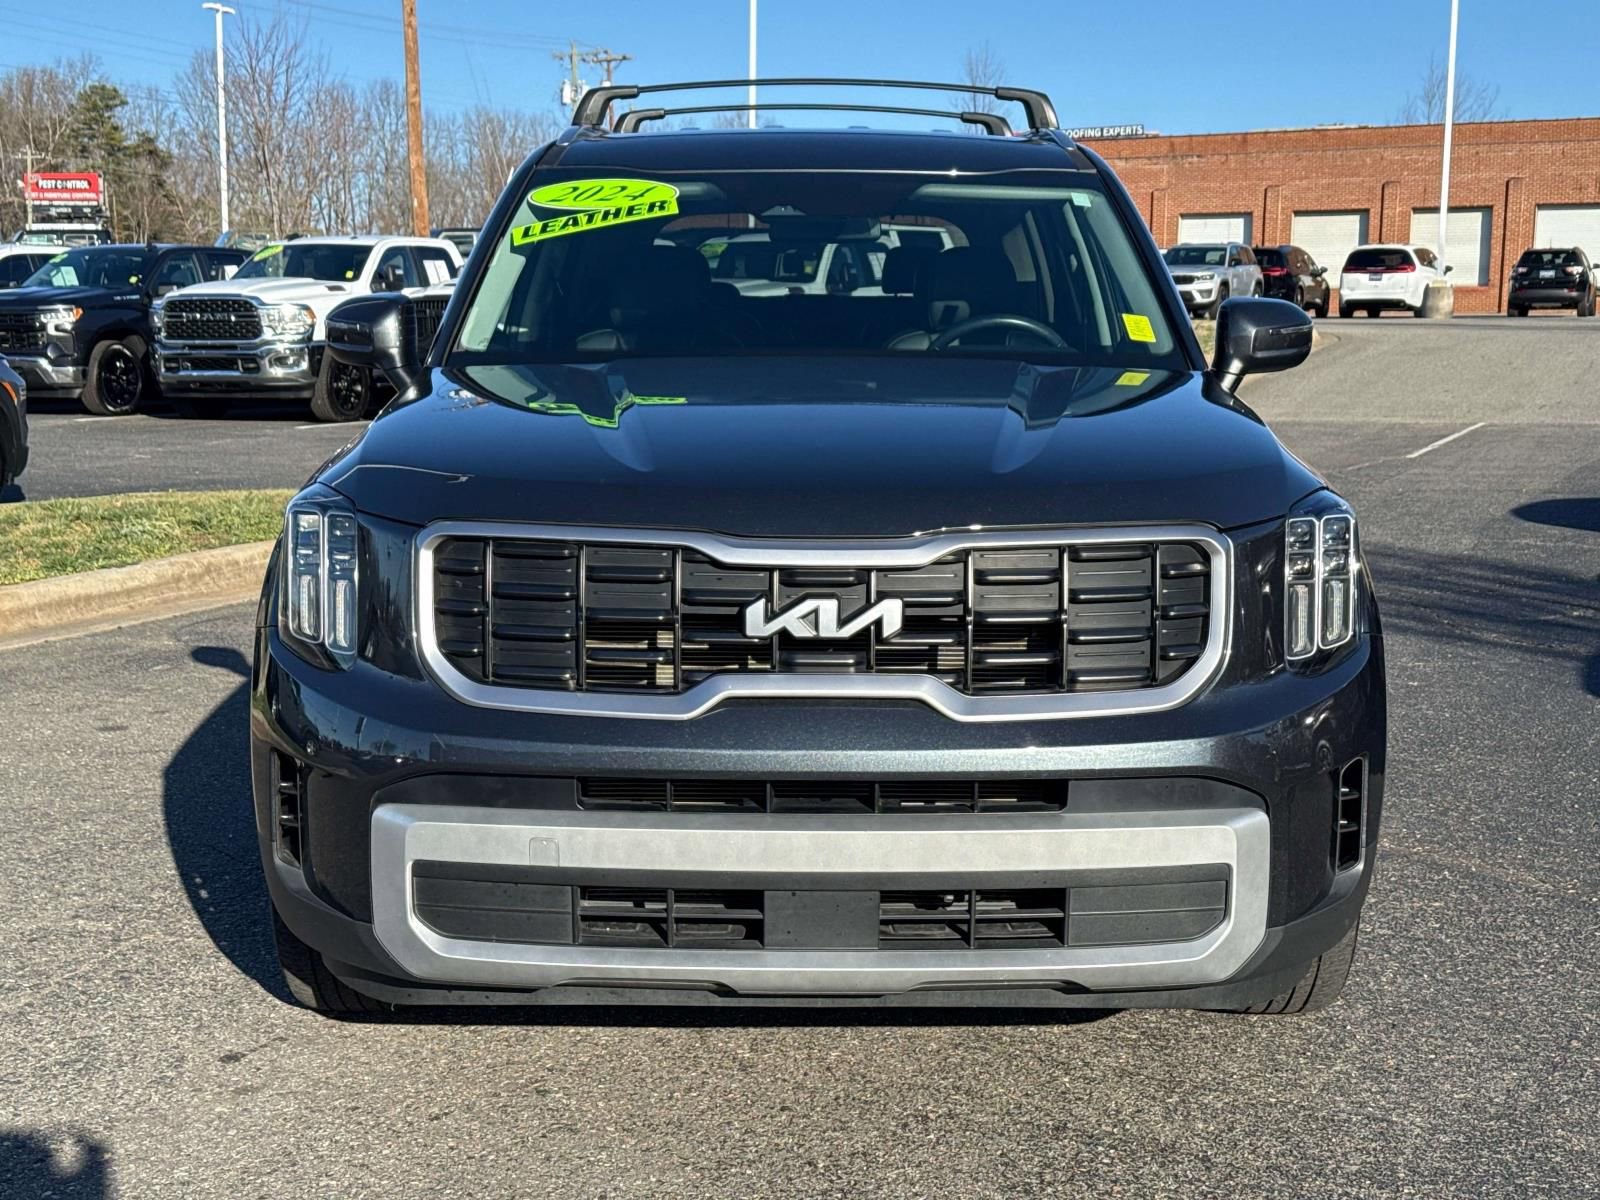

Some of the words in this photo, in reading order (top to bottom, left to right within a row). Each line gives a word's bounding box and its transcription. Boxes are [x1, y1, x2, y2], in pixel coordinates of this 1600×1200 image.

[1103, 126, 1143, 136] EXPERTS
[38, 179, 56, 189] PEST
[547, 184, 658, 202] 2024
[520, 199, 671, 240] LEATHER
[745, 598, 903, 639] KIA
